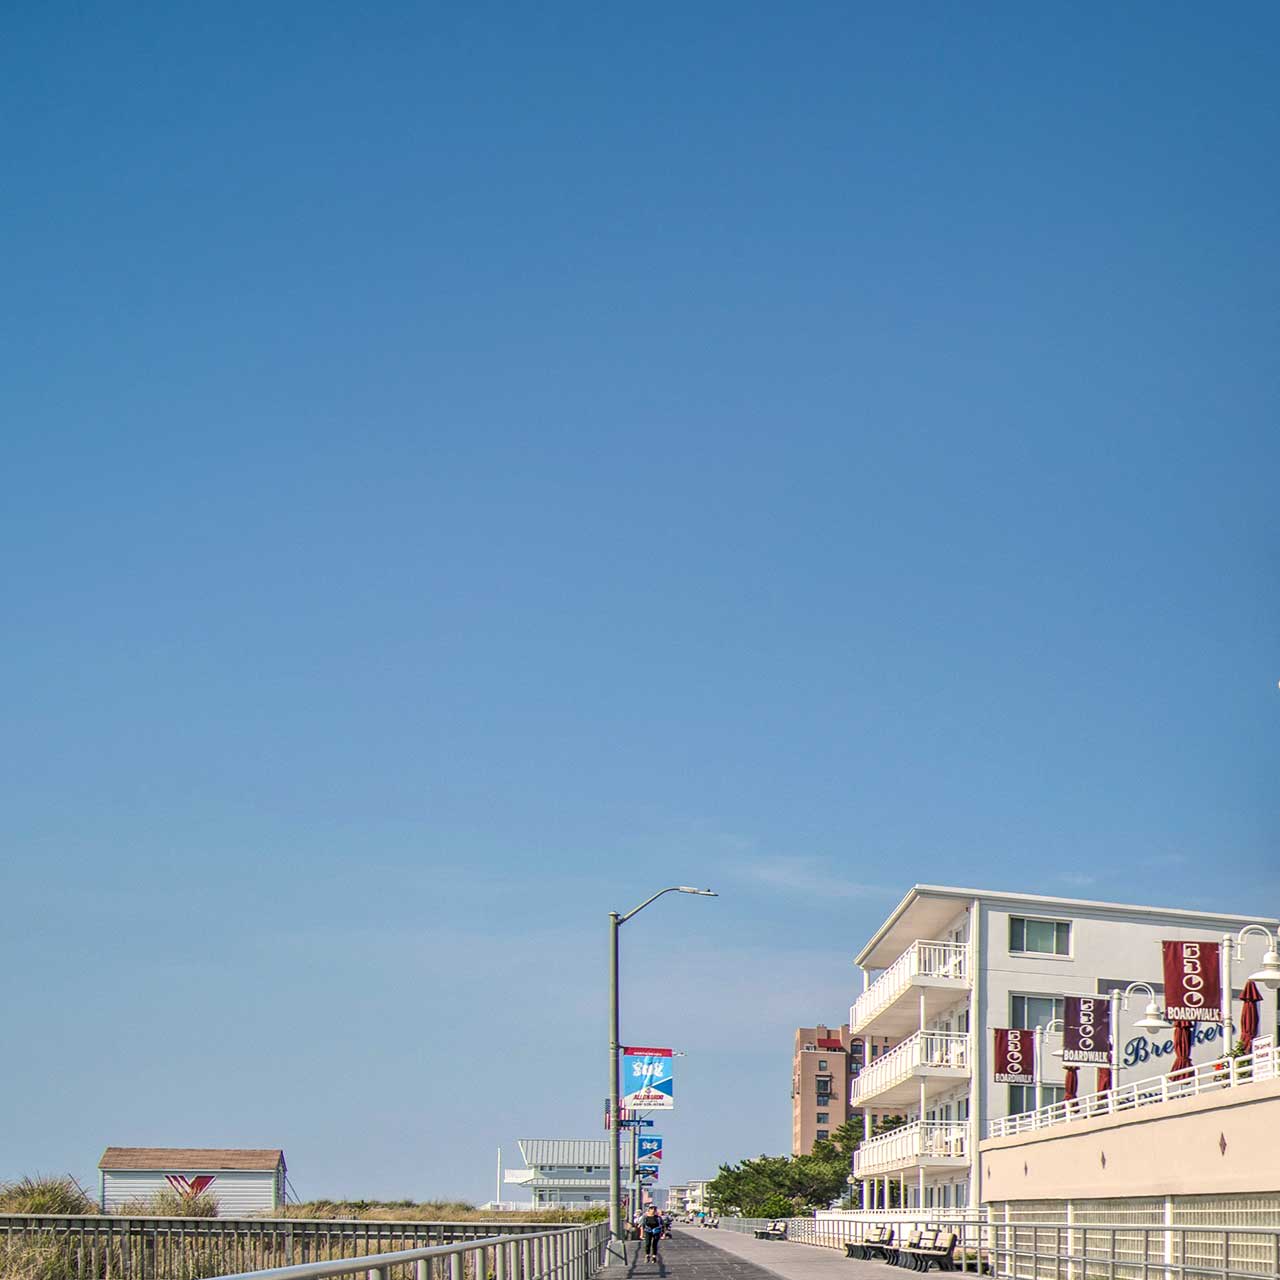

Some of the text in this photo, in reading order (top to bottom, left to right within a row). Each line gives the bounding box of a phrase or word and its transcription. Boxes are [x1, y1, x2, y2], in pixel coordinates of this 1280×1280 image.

[1167, 1006, 1220, 1021] BOARDWALK
[1123, 1021, 1236, 1066] Breker
[1063, 1049, 1108, 1062] BOARDWALK
[995, 1073, 1033, 1083] BOARDWALK
